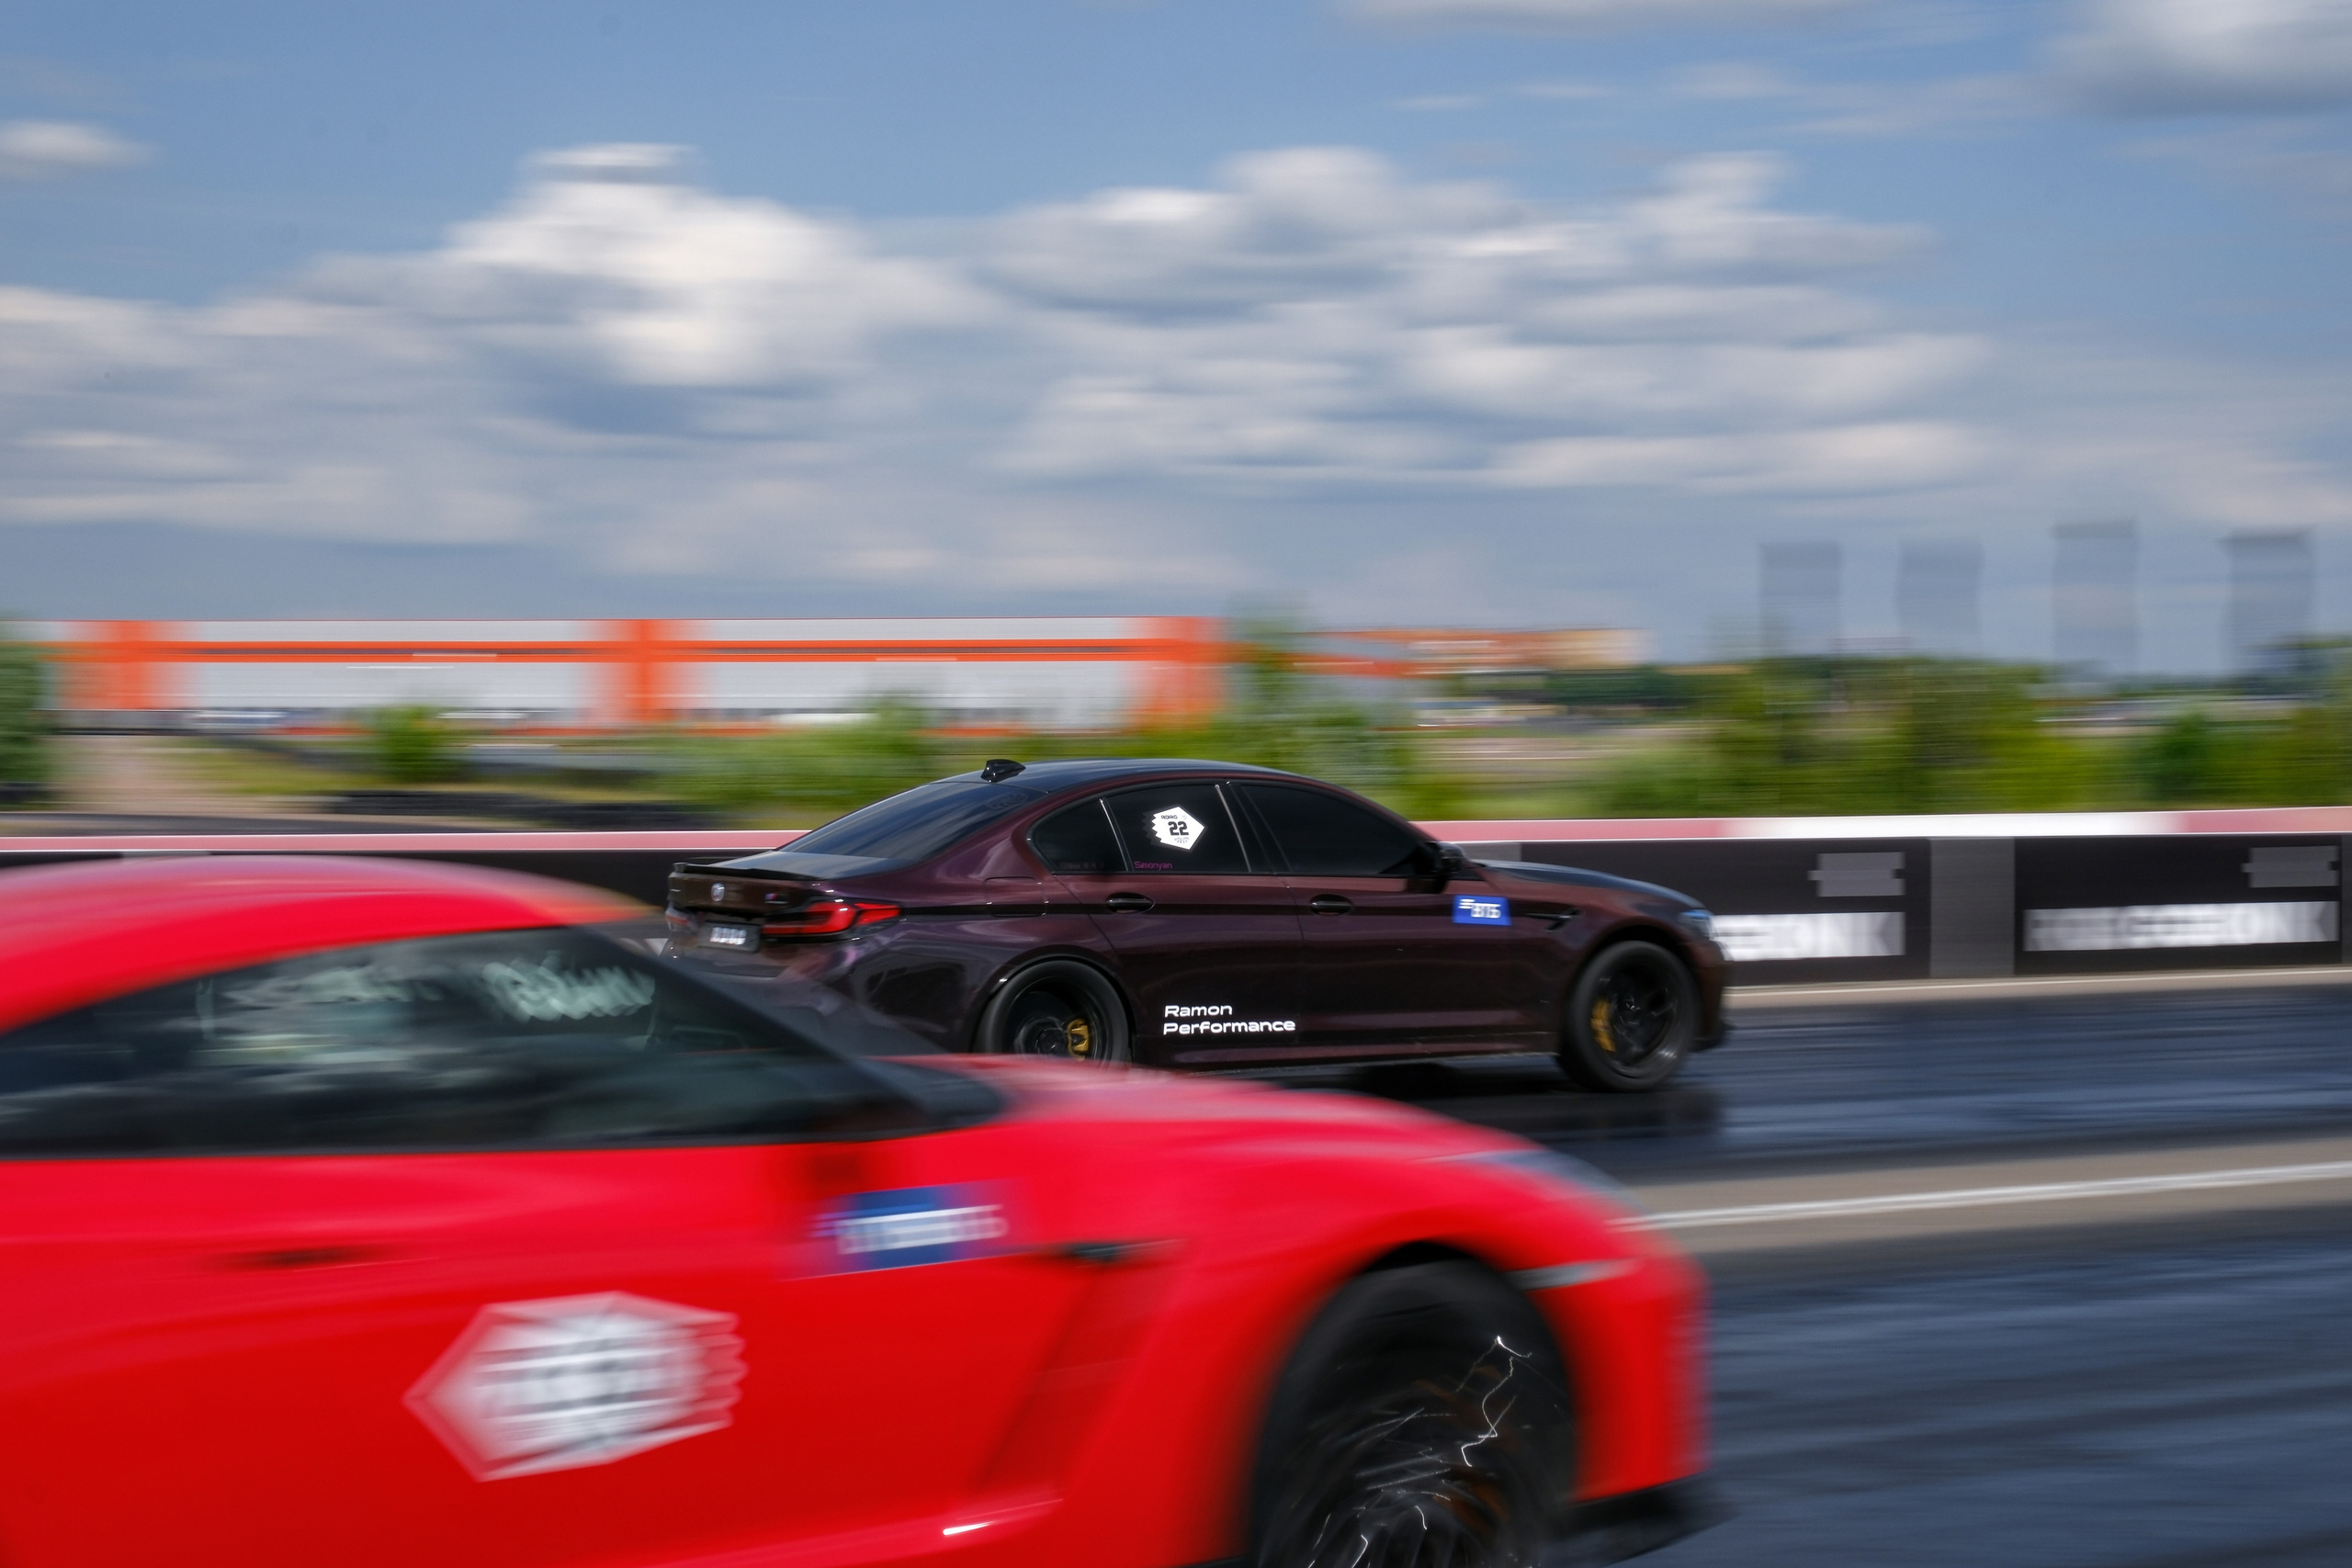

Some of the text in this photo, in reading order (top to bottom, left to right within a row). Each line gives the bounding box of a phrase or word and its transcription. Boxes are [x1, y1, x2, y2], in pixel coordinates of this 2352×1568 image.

[1168, 821, 1189, 836] 22
[1164, 1005, 1233, 1018] Ramon
[1163, 1020, 1296, 1035] Performance
